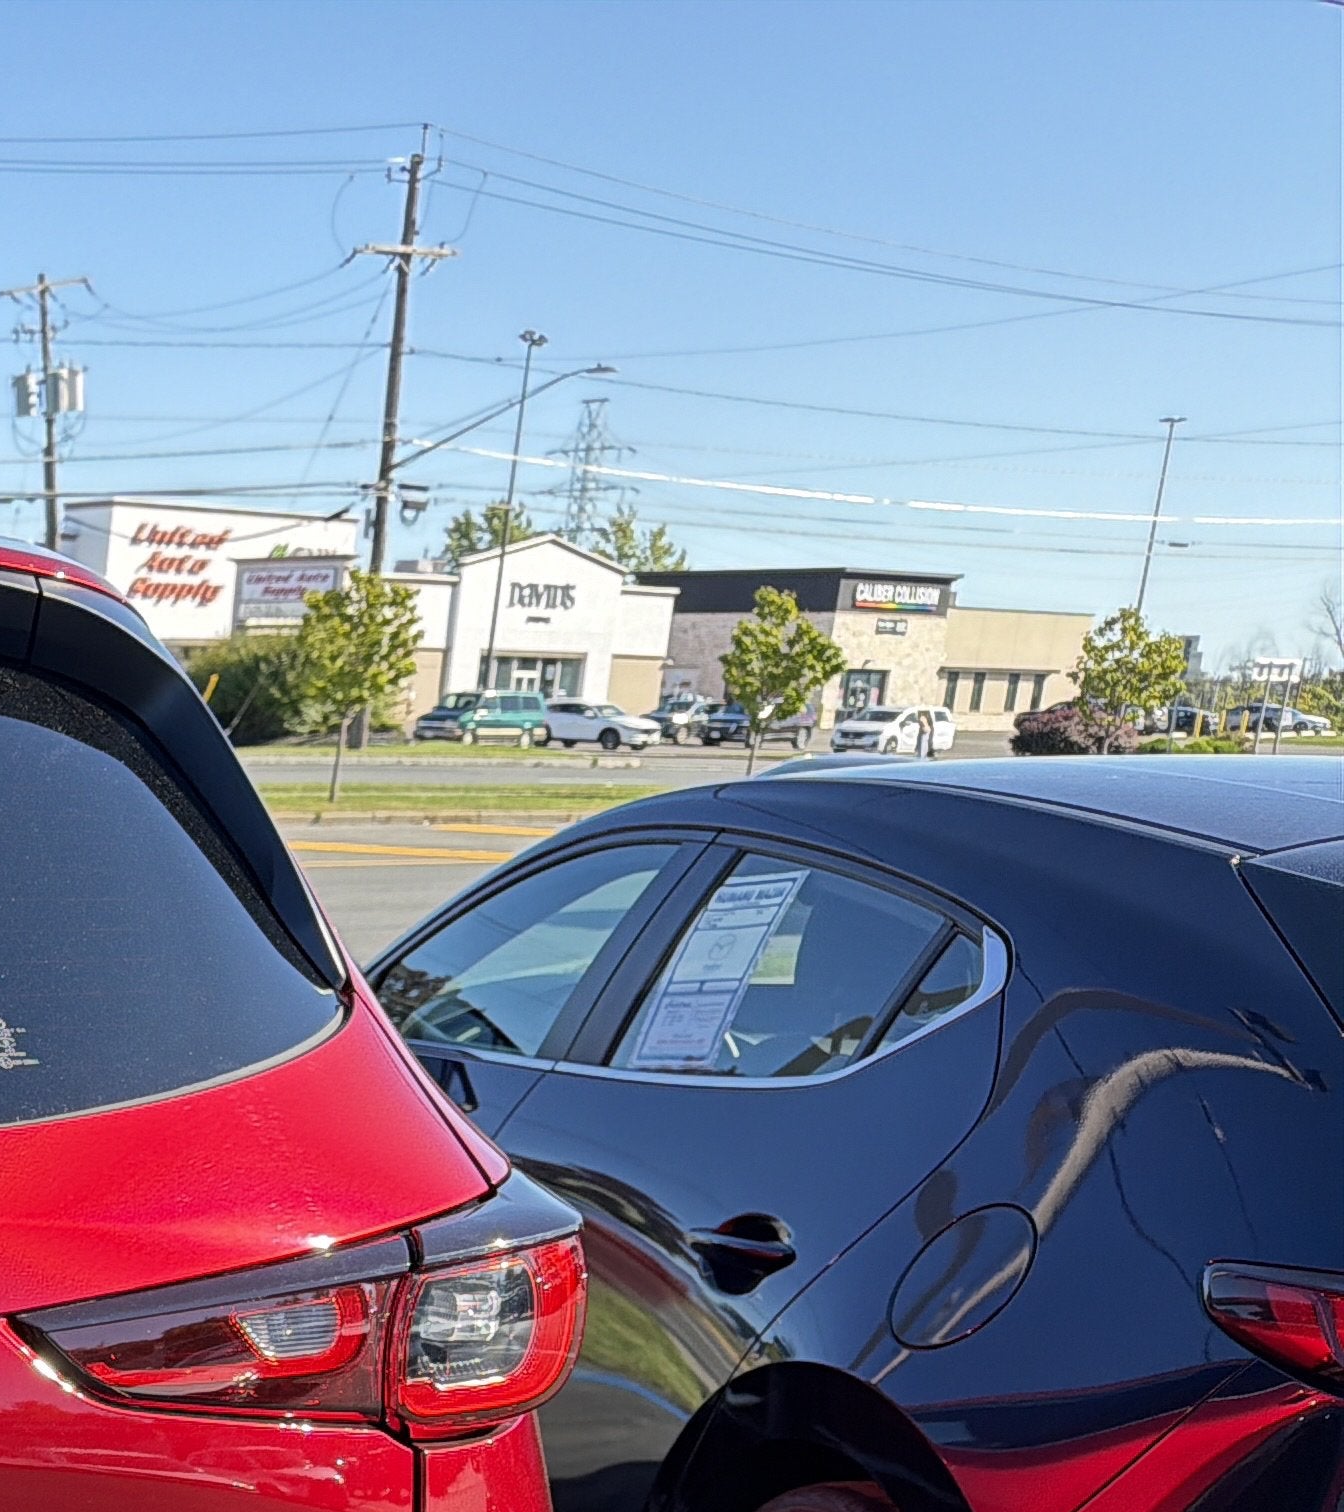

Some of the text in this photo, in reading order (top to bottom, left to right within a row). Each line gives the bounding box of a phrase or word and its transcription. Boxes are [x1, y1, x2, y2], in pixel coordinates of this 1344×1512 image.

[130, 522, 233, 550] United
[135, 551, 212, 575] Auto
[126, 578, 225, 607] Supply
[855, 582, 941, 605] CALIBER COLLISION
